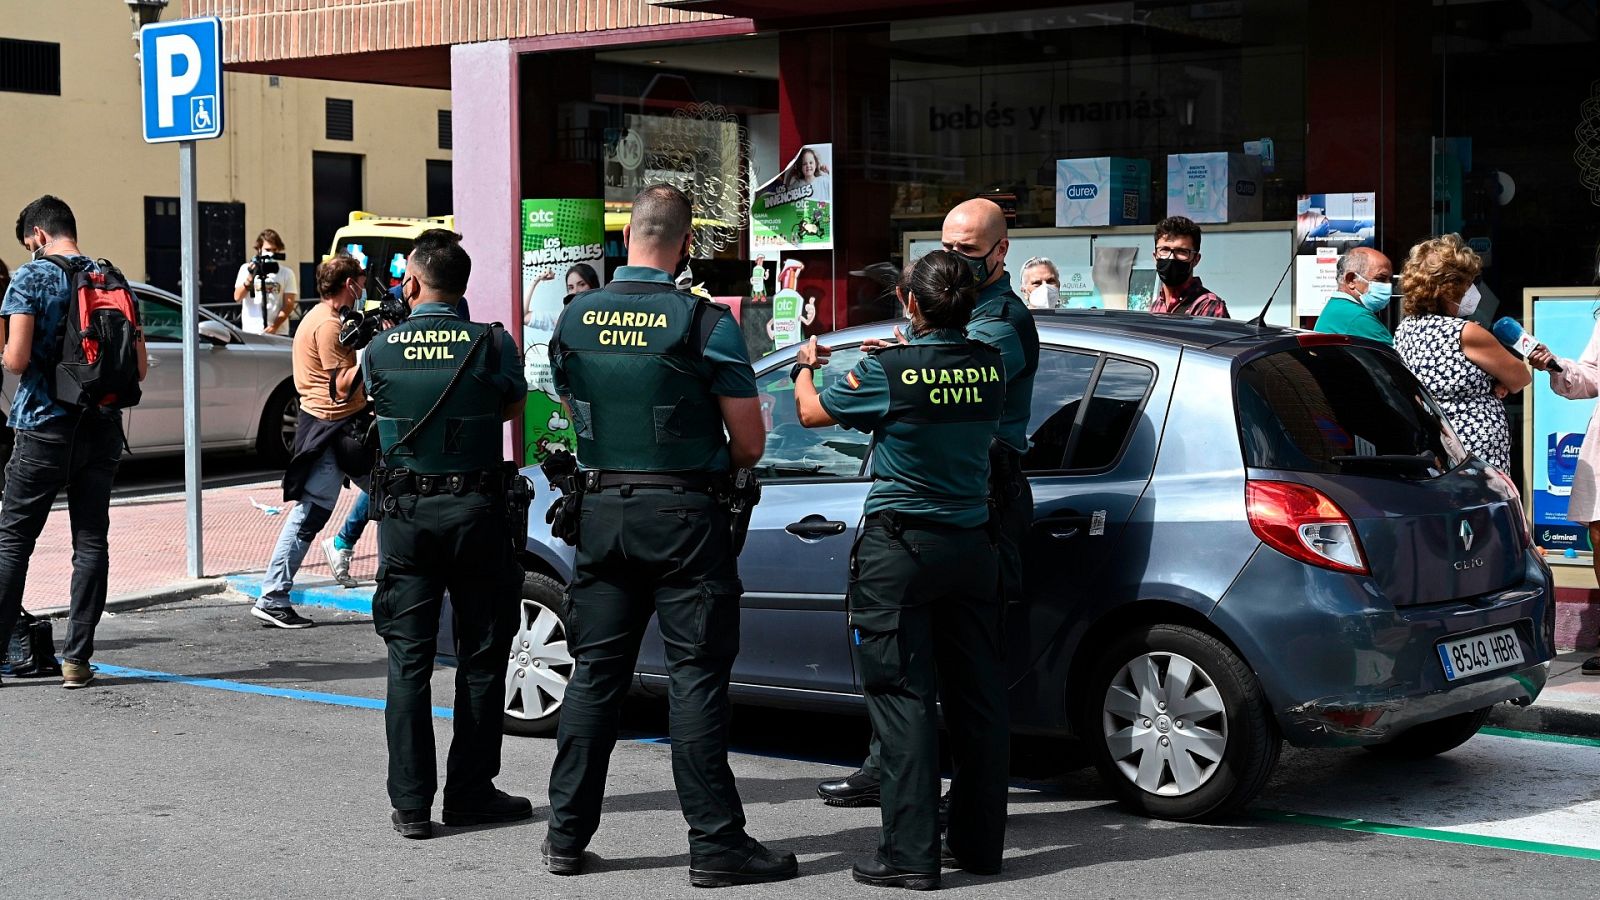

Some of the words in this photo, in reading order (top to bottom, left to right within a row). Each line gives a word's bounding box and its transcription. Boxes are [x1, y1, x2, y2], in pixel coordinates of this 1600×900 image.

[156, 33, 202, 128] P
[929, 101, 1016, 131] bebés
[1029, 104, 1046, 130] y
[1059, 91, 1168, 123] mamás
[764, 184, 813, 208] INVENCIBLES
[776, 185, 786, 193] LOS
[1068, 185, 1097, 198] durex
[795, 199, 809, 208] otc
[529, 209, 554, 223] otc
[544, 237, 561, 249] LOS
[523, 243, 604, 265] INVENCIBLES
[777, 299, 793, 311] otc
[582, 310, 667, 328] GUARDIA
[387, 330, 470, 344] GUARDIA
[599, 330, 647, 346] CIVIL
[404, 346, 453, 360] CIVIL
[901, 366, 1000, 385] GUARDIA
[930, 387, 982, 404] CIVIL
[1562, 444, 1581, 454] Alm
[1454, 558, 1484, 570] CLIO
[1452, 640, 1490, 673] 8549
[1489, 634, 1520, 664] HBR
